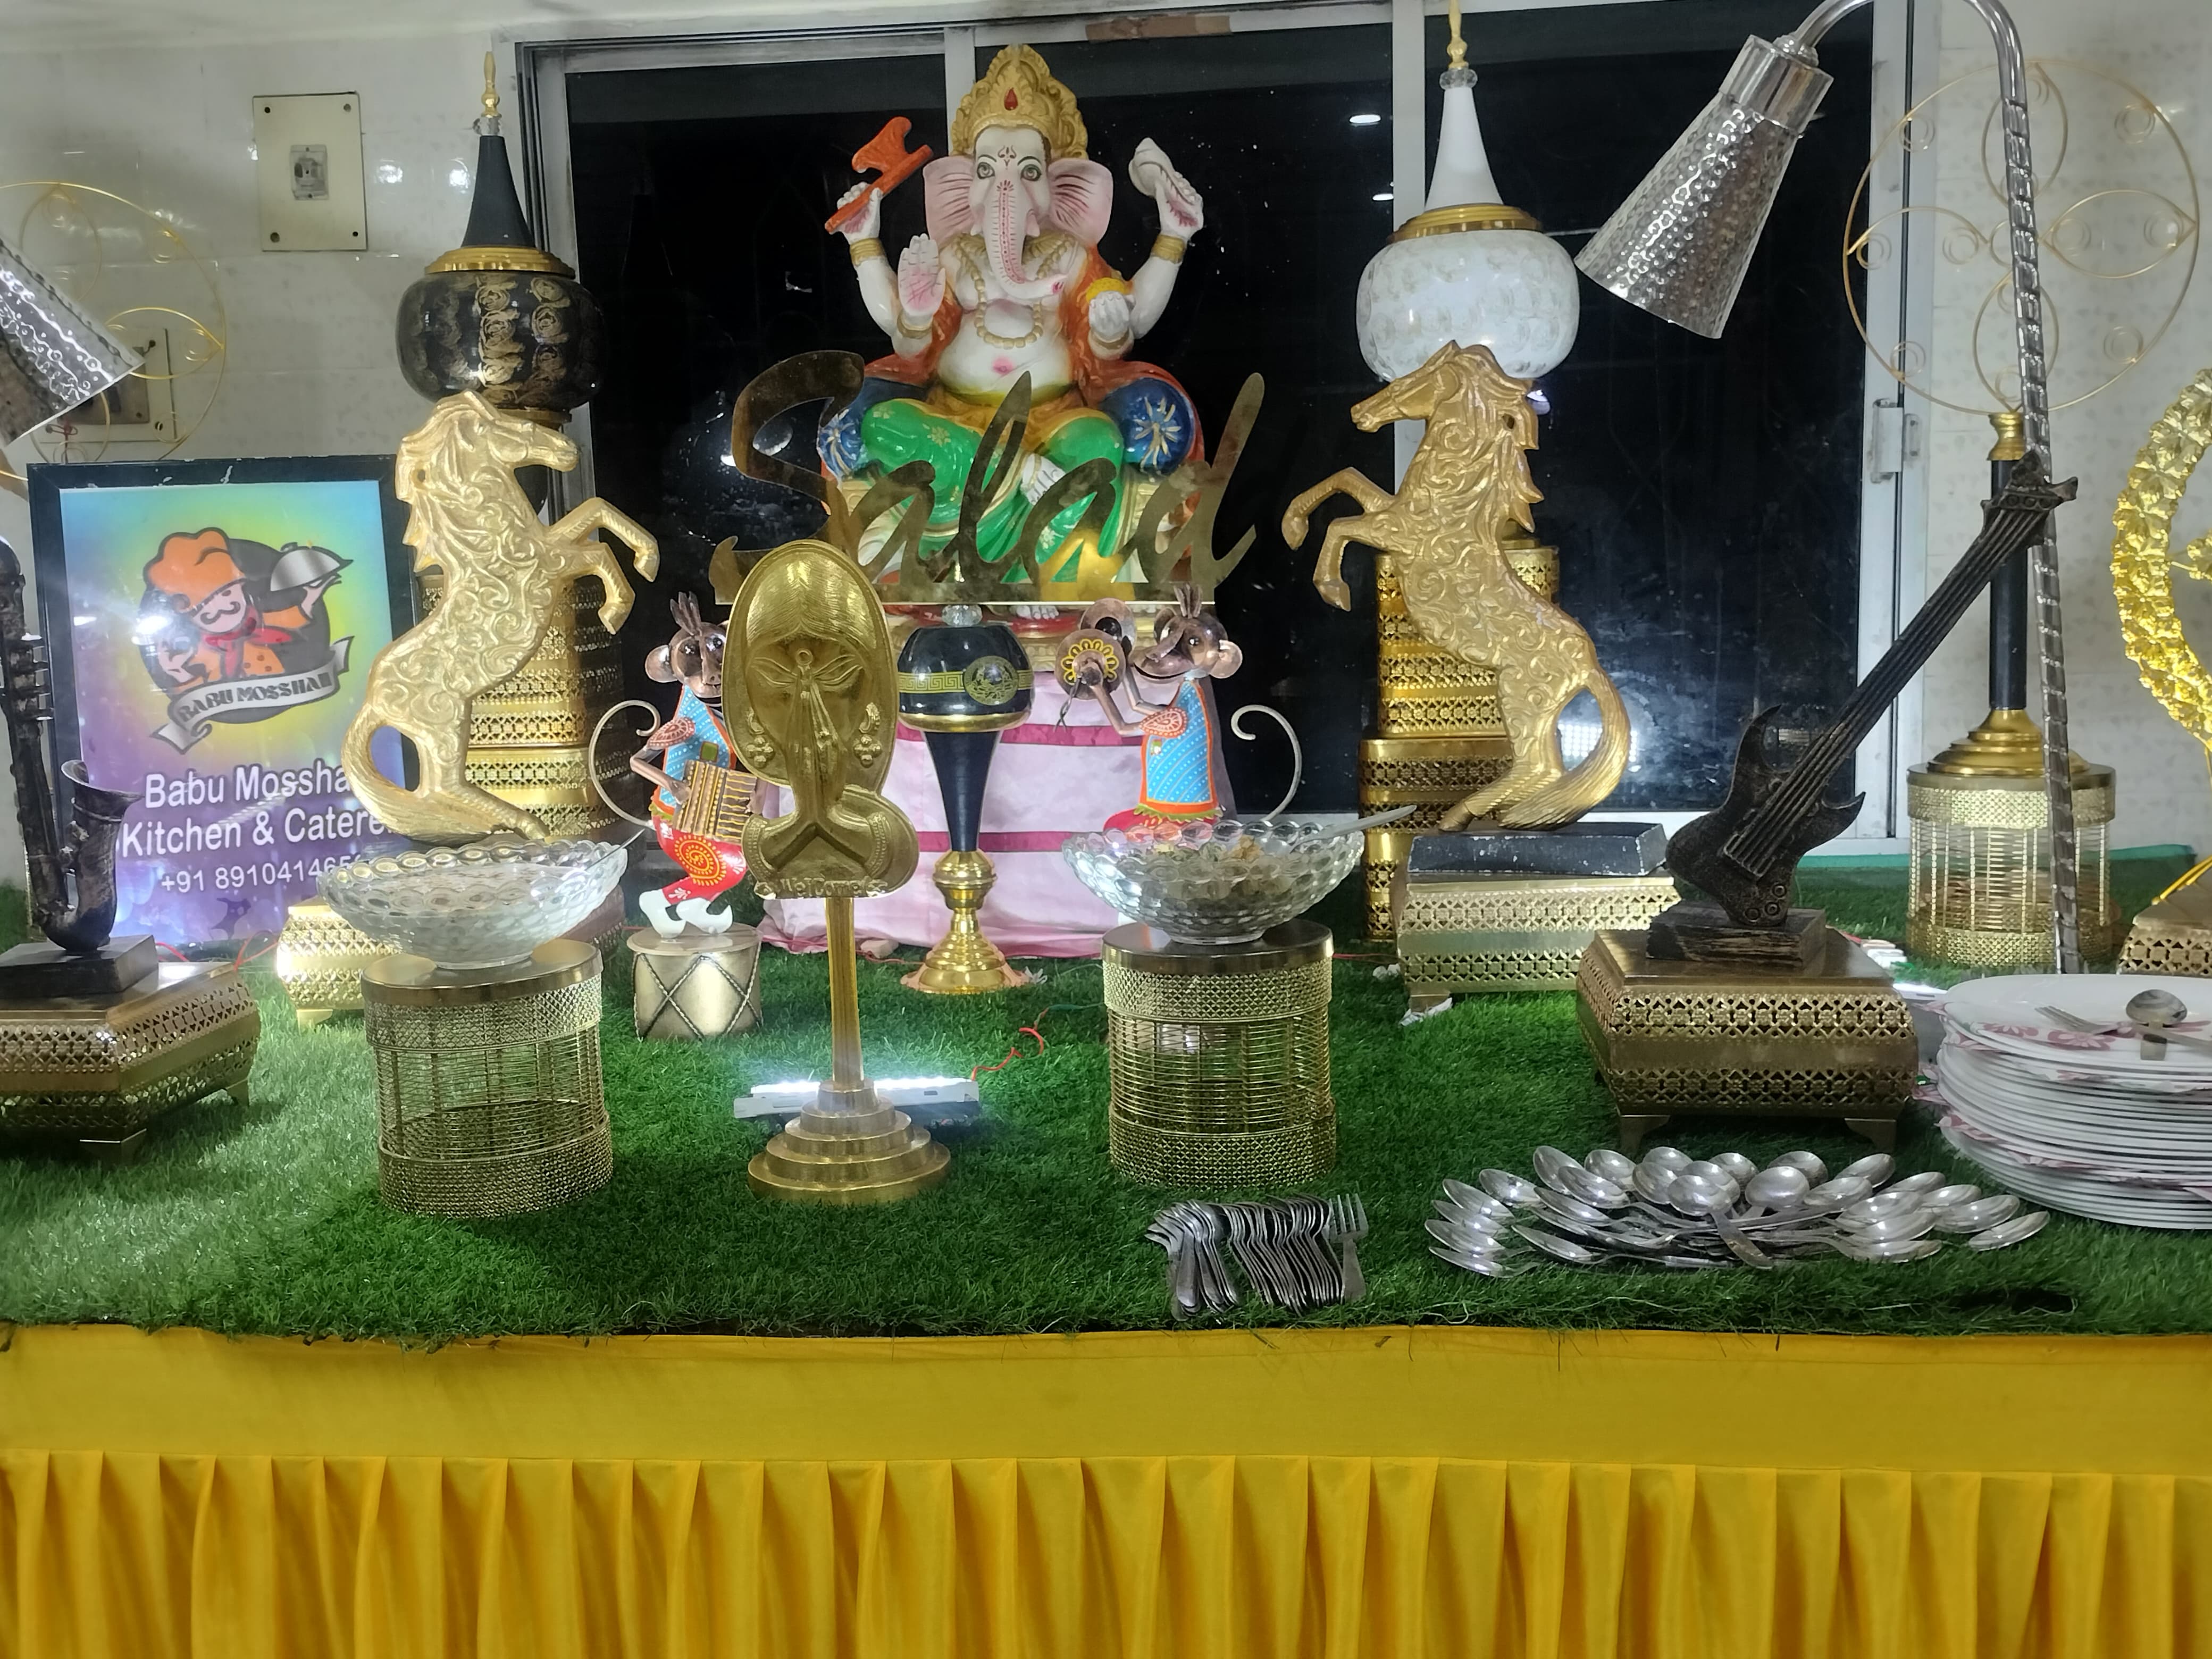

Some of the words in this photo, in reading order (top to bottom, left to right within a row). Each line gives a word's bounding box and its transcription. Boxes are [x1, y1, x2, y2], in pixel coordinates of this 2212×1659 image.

[709, 349, 1265, 600] Salad
[177, 689, 233, 722] BABU
[145, 769, 224, 809] Babu
[236, 760, 351, 801] Mossha
[122, 817, 241, 858] Kitchen
[253, 811, 274, 846] &
[284, 806, 392, 843] Catere
[161, 870, 205, 893] +91
[215, 854, 362, 890] 891041465
